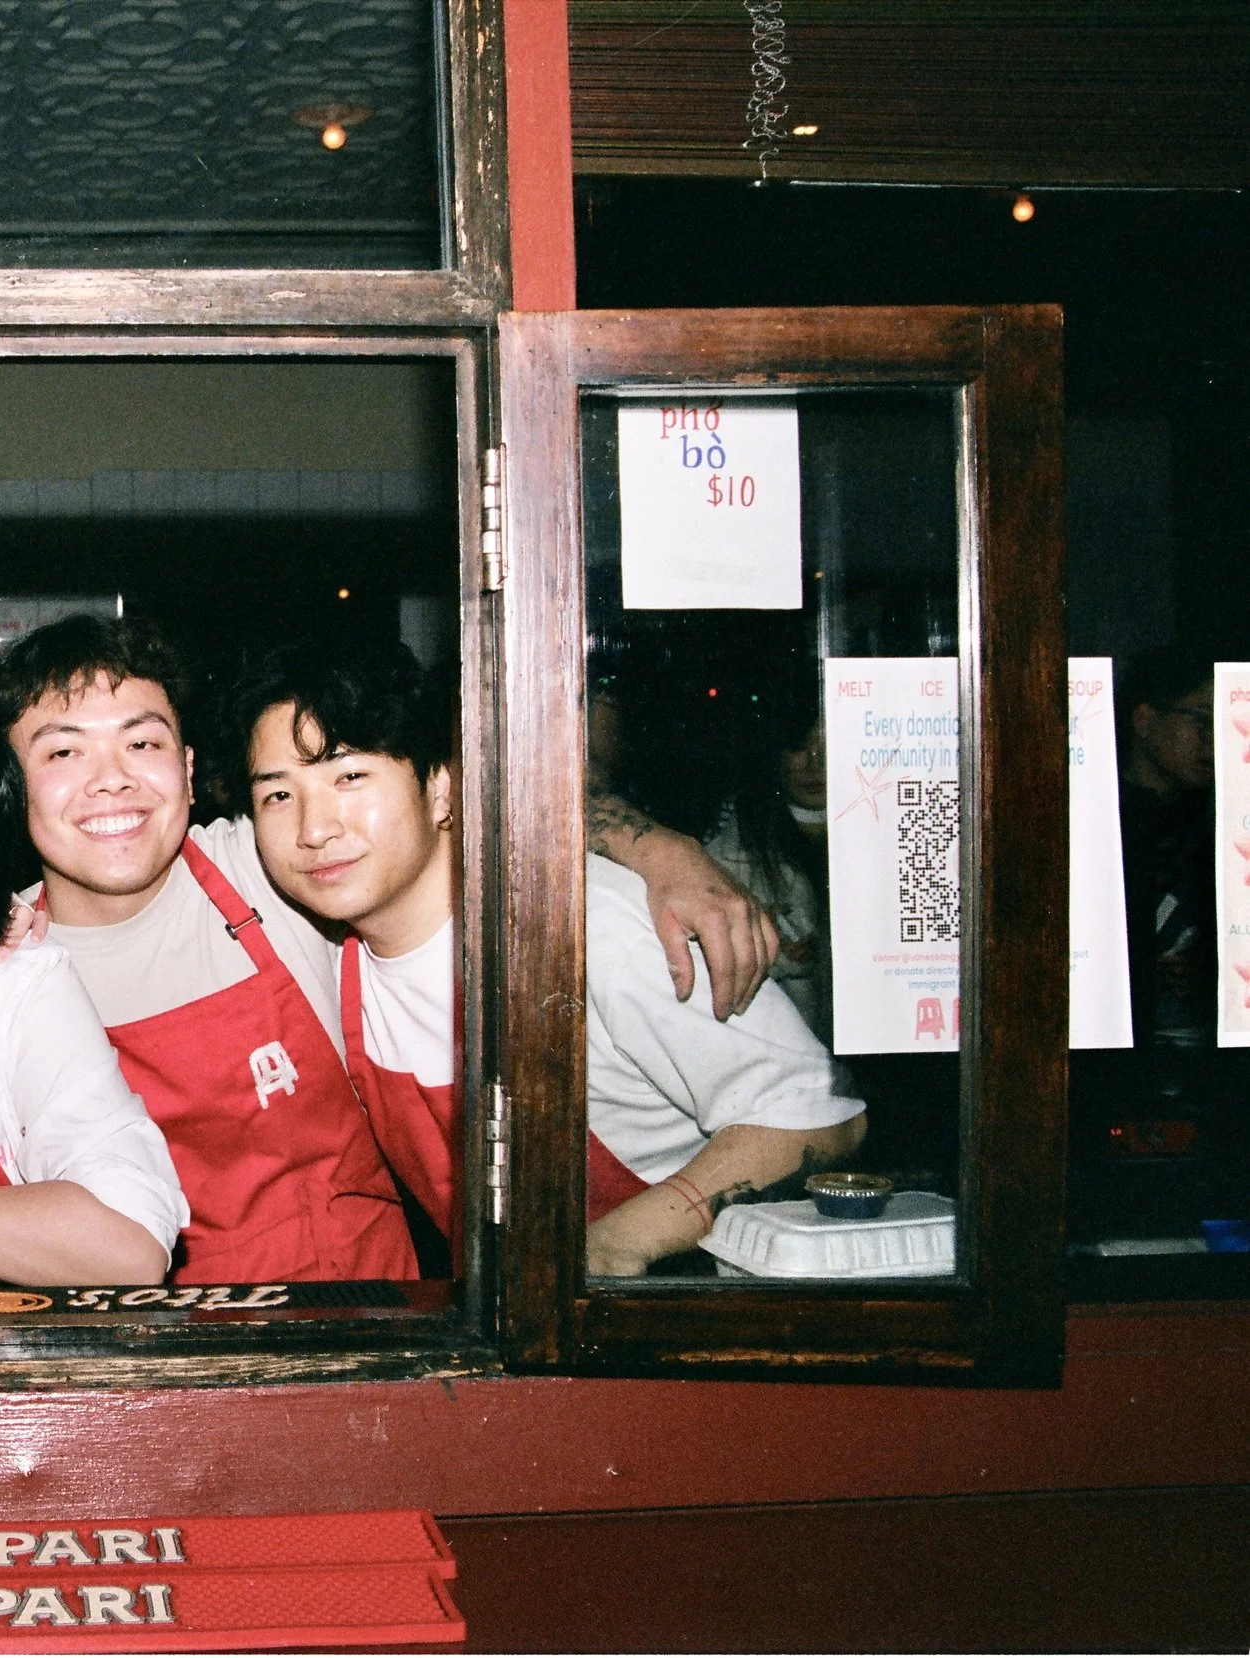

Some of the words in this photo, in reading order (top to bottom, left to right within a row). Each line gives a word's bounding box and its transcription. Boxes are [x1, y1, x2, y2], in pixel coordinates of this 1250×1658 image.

[680, 432, 727, 469] bò
[707, 473, 755, 507] $10
[838, 680, 873, 697] MELT
[920, 680, 943, 697] ICE
[864, 710, 902, 742] Every
[860, 742, 934, 769] community
[938, 742, 951, 767] in
